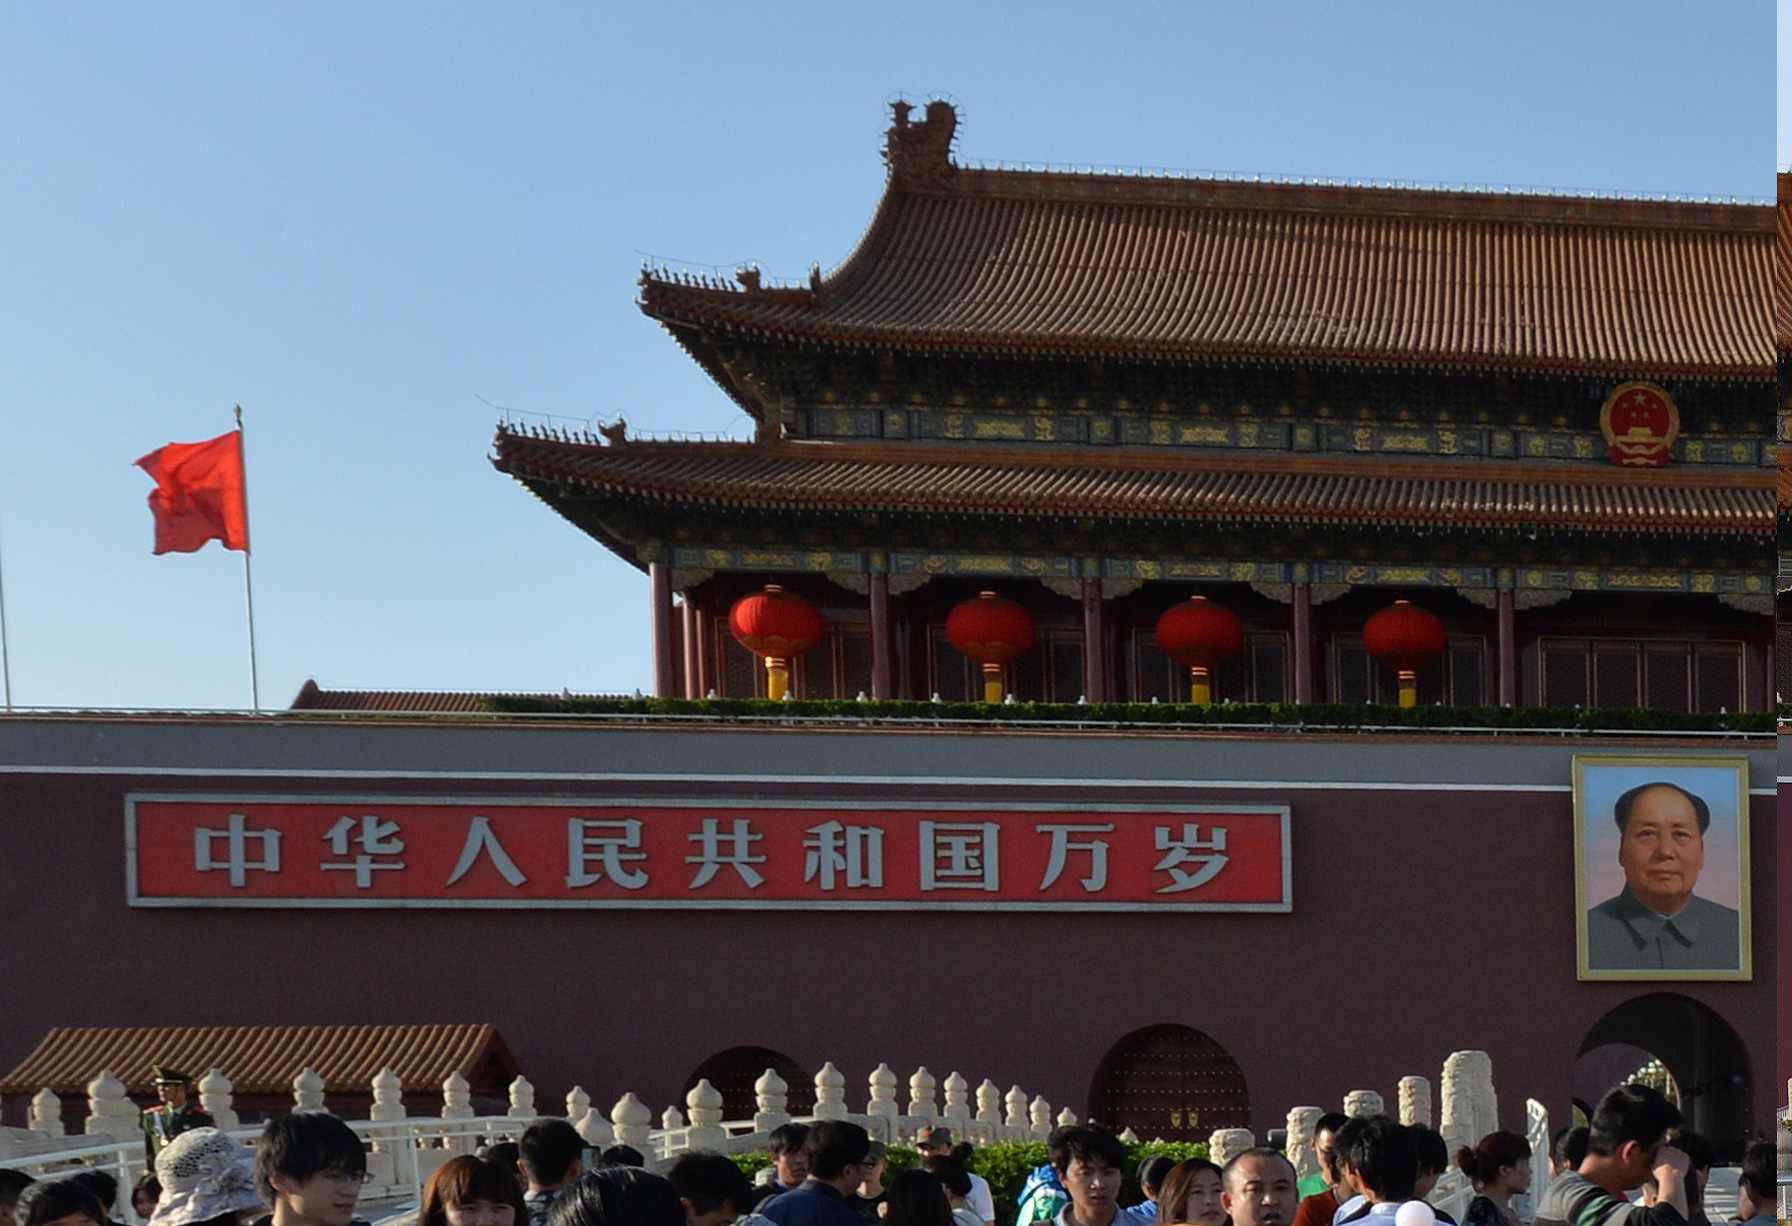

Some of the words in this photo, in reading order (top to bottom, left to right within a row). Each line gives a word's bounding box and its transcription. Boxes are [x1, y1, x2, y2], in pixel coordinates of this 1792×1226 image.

[194, 814, 1230, 893] 中华人民共和国万岁
